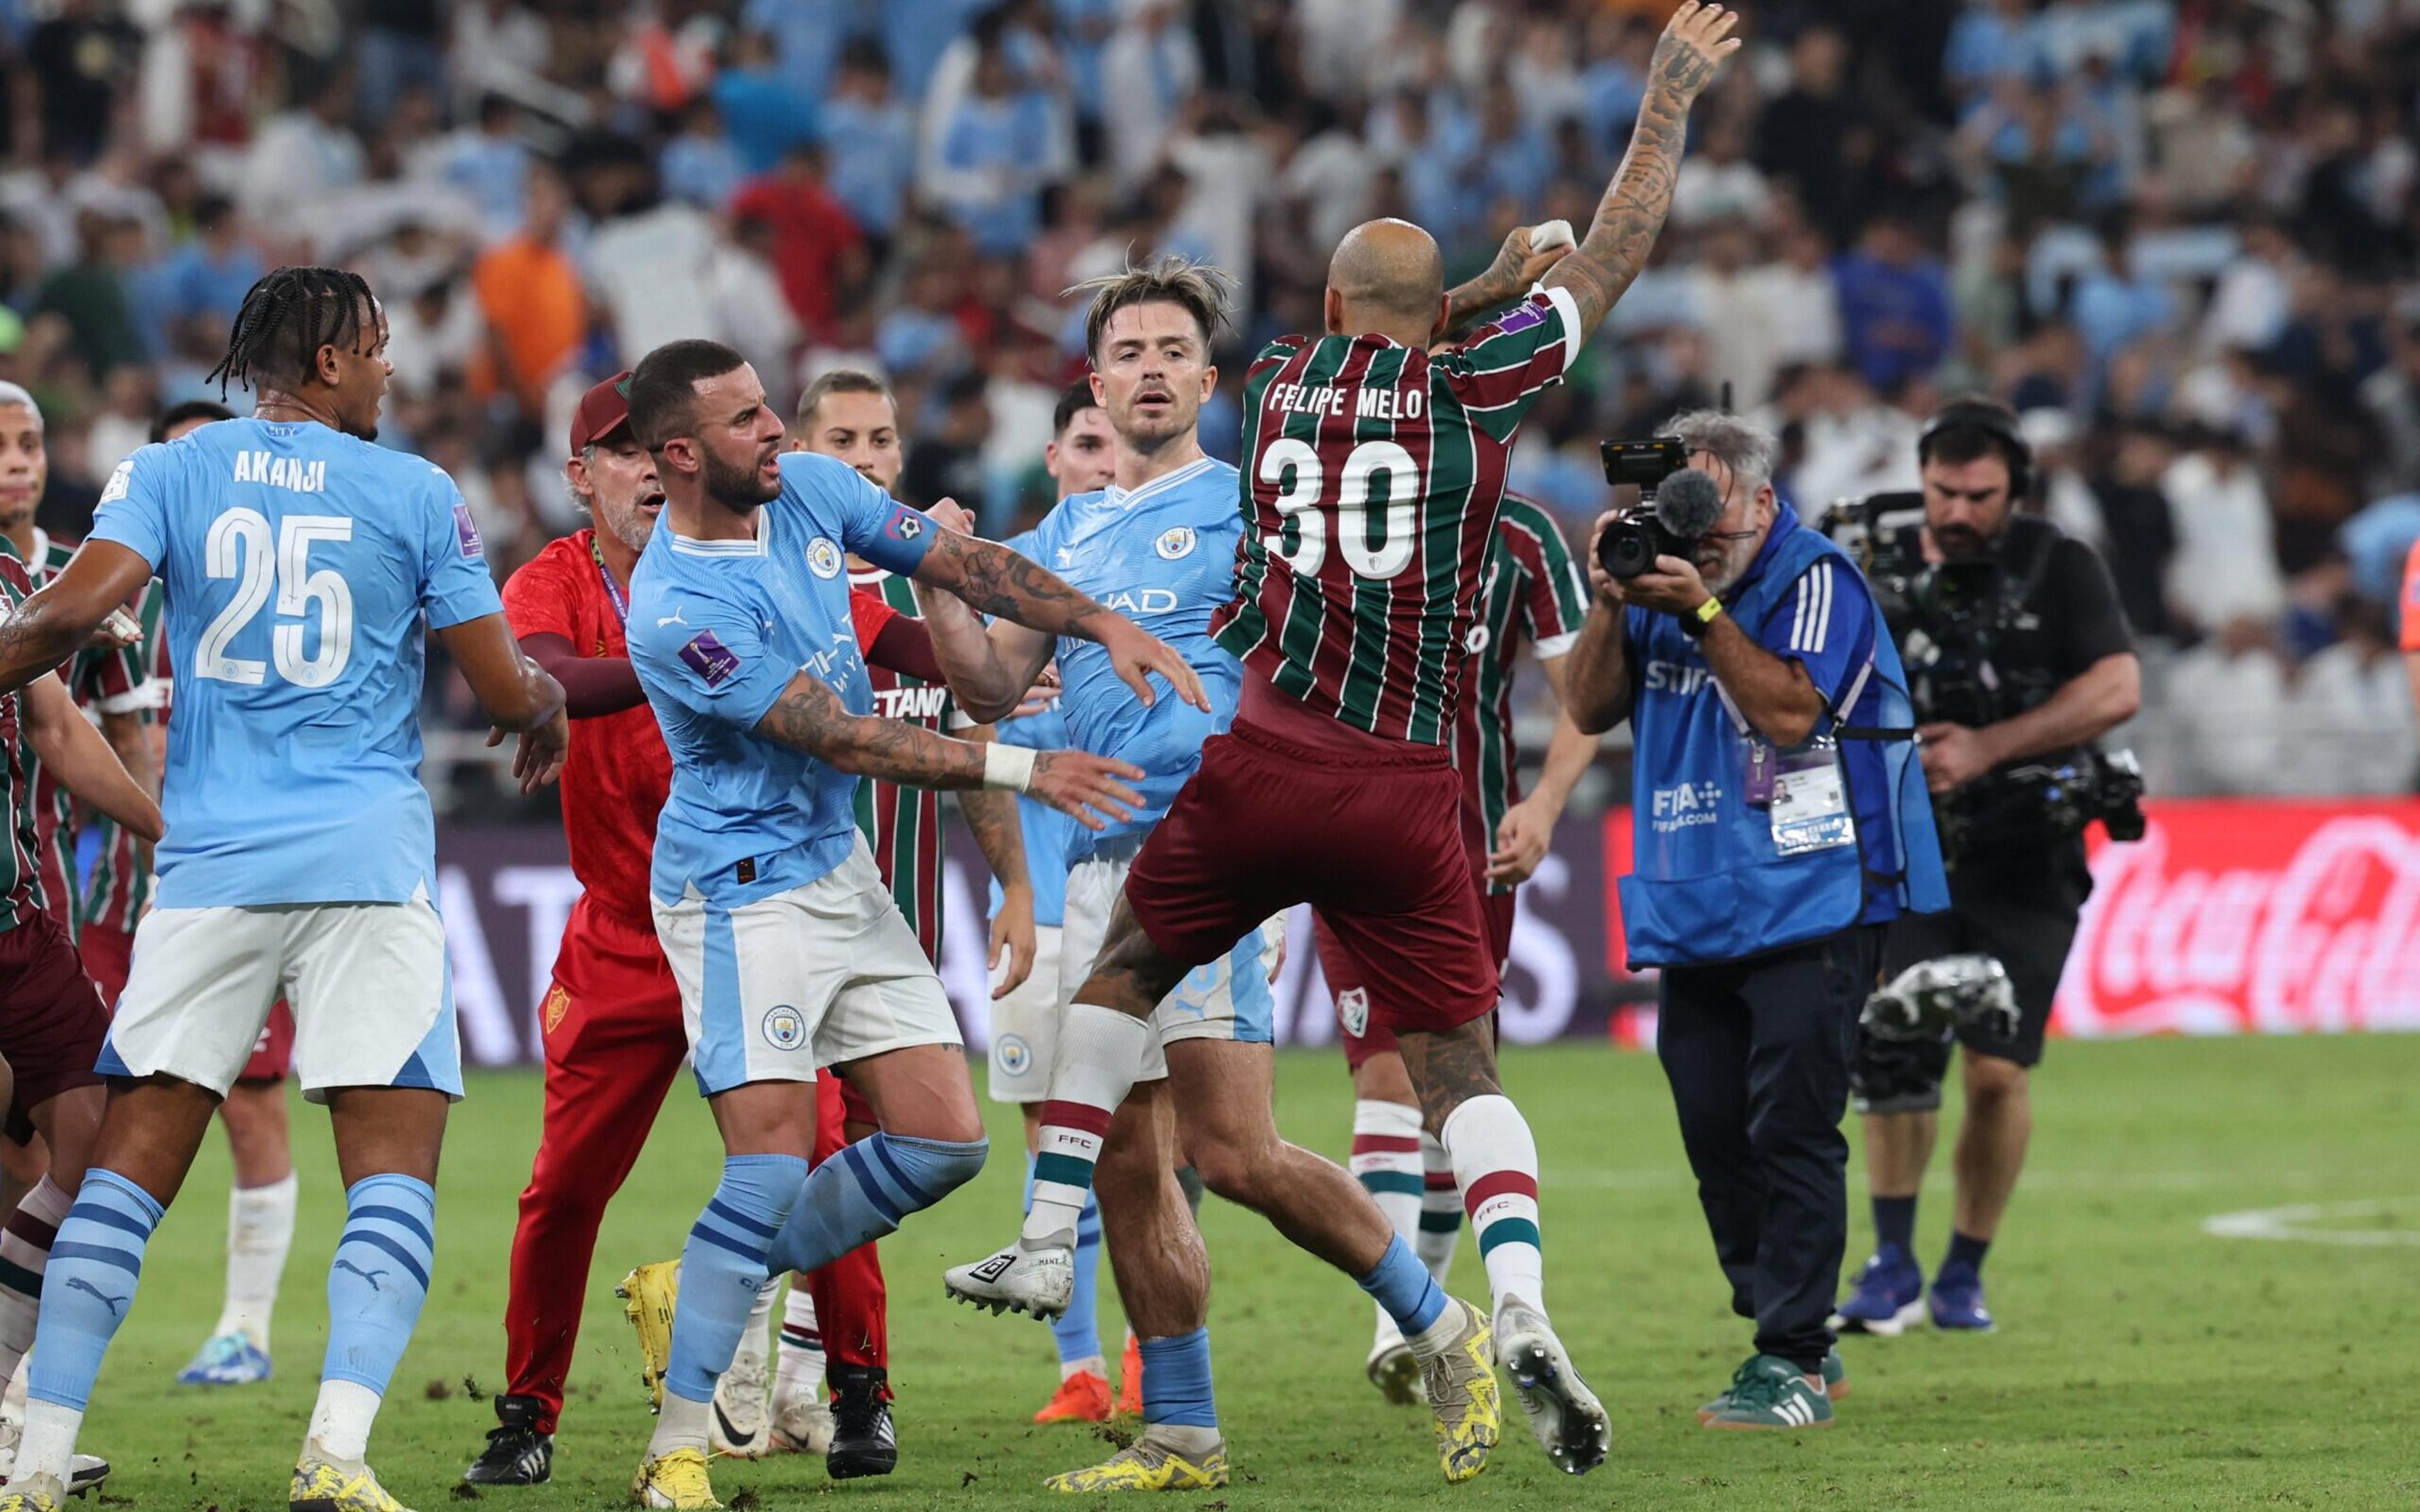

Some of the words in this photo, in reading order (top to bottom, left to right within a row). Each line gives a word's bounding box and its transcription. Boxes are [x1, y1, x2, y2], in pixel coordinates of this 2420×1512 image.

[1269, 383, 1347, 416] FELIPE
[1356, 387, 1422, 419] MELO
[234, 450, 326, 493] AKANJI
[1259, 438, 1420, 580] 30
[195, 507, 354, 689] 25
[1059, 1135, 1091, 1149] FFC
[1478, 1201, 1509, 1221] FFC
